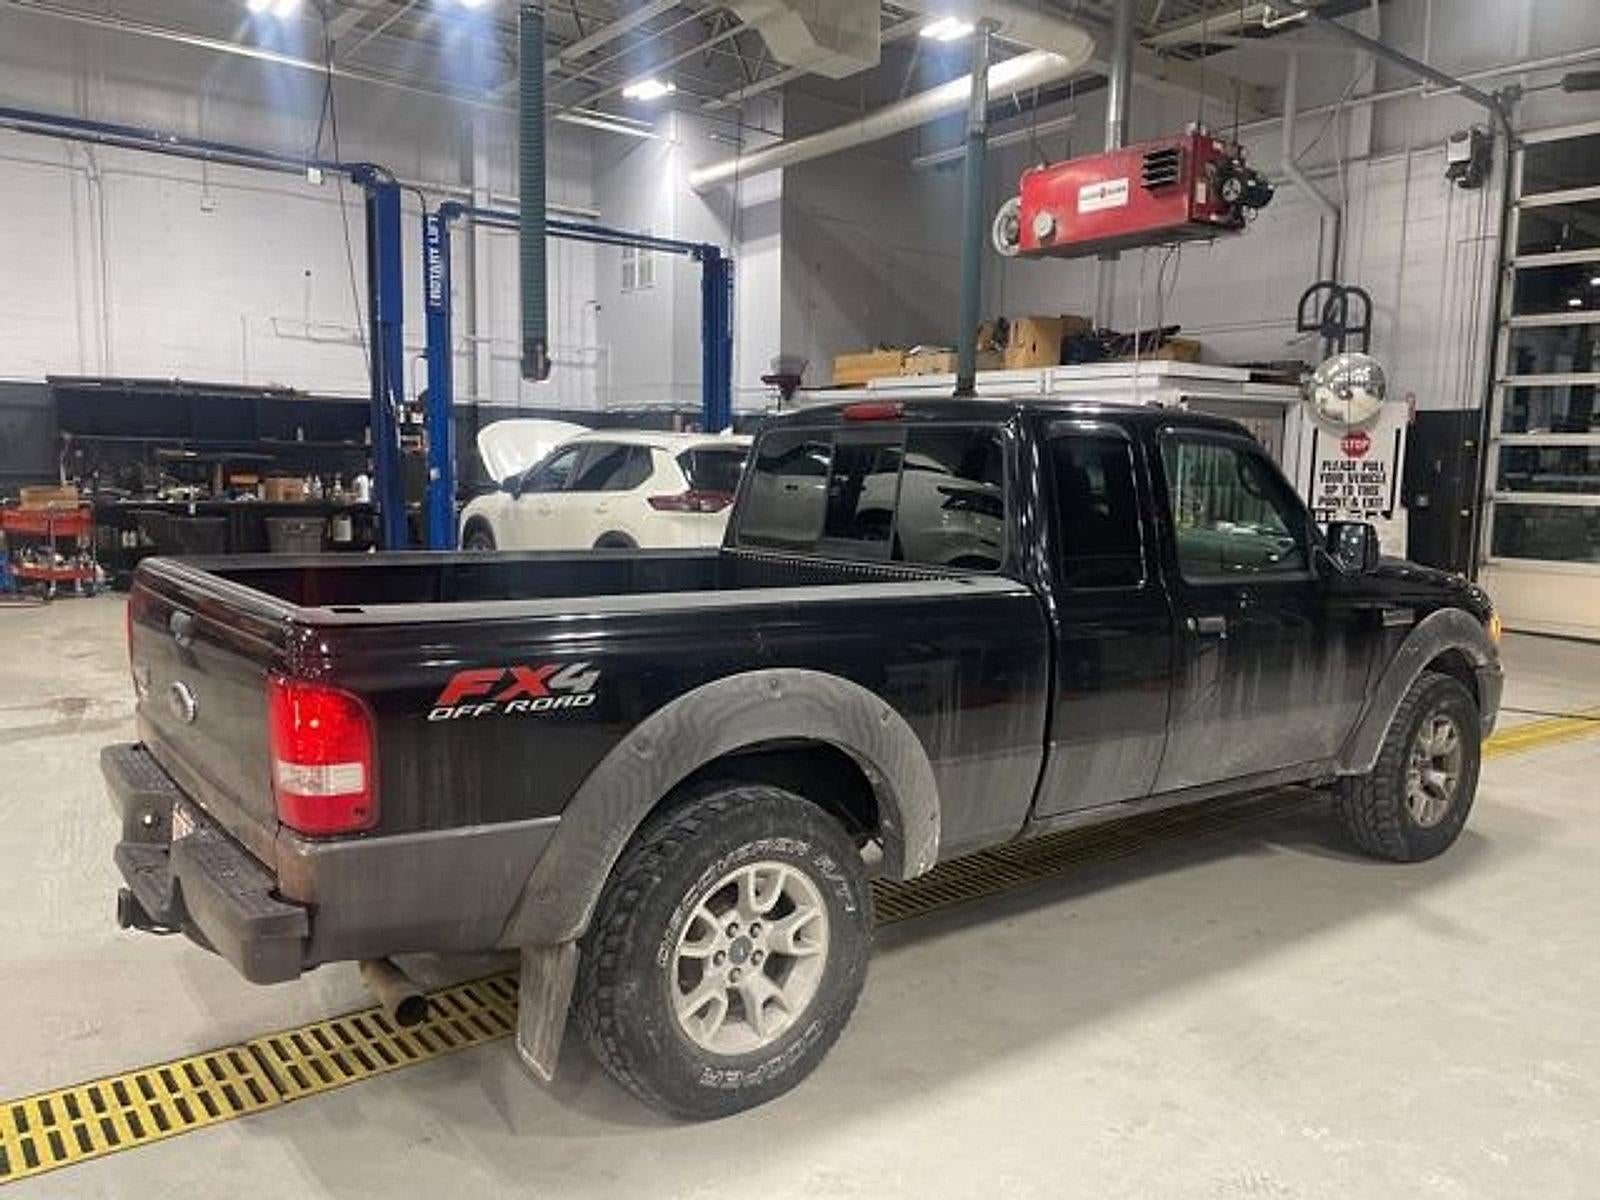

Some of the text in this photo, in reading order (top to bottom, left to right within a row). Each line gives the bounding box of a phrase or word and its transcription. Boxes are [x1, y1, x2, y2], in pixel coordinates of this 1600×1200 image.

[427, 216, 439, 243] LIFT
[1342, 440, 1369, 449] STOP
[1322, 460, 1384, 471] PLEASE PULL
[1320, 472, 1386, 483] YOUR VEHICLE
[1325, 485, 1379, 496] UP TO THIS
[1318, 497, 1384, 508] POINT & EXIT
[434, 661, 602, 706] FX4
[427, 693, 597, 722] OFF ROAD
